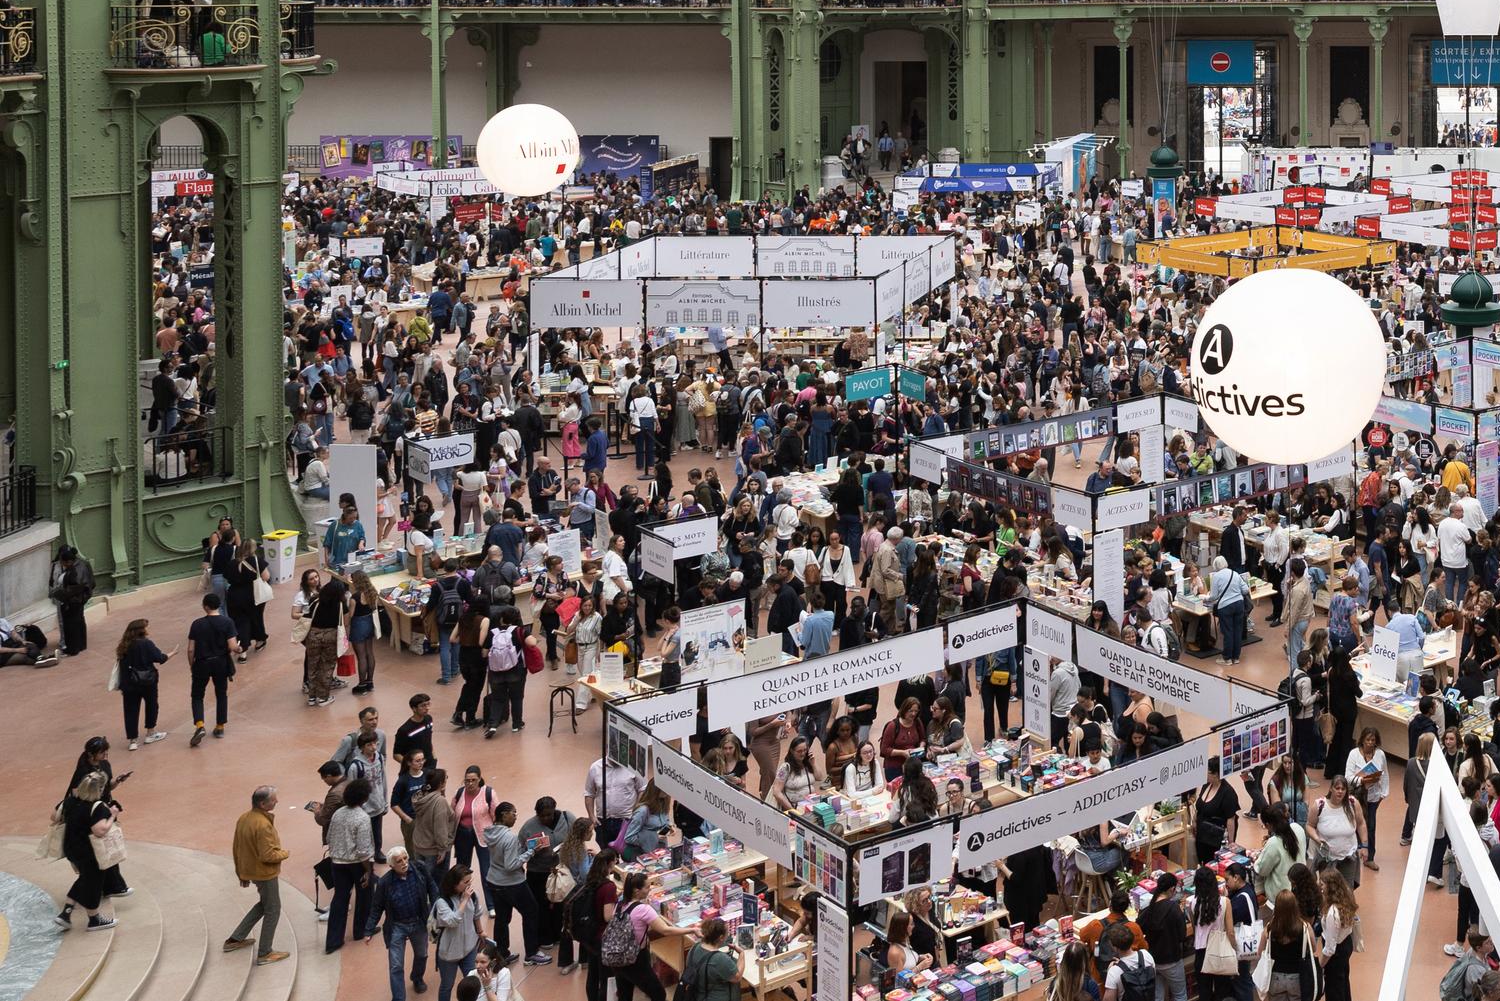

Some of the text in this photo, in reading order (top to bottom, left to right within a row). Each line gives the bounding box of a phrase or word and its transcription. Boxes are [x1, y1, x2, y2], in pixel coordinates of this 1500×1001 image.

[1434, 47, 1500, 56] SORTIE EXIT
[184, 171, 195, 181] LU
[436, 182, 459, 196] folio
[680, 249, 731, 260] Littérature
[797, 296, 841, 307] Illustrés
[550, 302, 622, 317] Albin Michel
[1450, 346, 1457, 355] 10
[1450, 357, 1458, 366] 18
[852, 377, 884, 393] PAYOT
[1123, 407, 1155, 421] ACTES SUD
[1441, 420, 1467, 433] POCKET
[430, 449, 460, 462] LAFON
[433, 443, 458, 454] Michel
[1314, 454, 1346, 471] ACTES SUD
[1059, 502, 1087, 517] ACTES SUD
[1105, 501, 1144, 517] ACTES SUD
[684, 531, 706, 540] MOTS
[965, 621, 1014, 644] addictives
[1040, 626, 1065, 646] ADONIA
[1373, 643, 1396, 661] Grèce
[762, 648, 893, 693] QUAND LA ROMANCE
[1099, 646, 1200, 694] QUAND LA ROMANCE
[753, 660, 903, 711] RENCONTRE LA FANTASY
[1025, 671, 1048, 686] addictives
[1109, 663, 1191, 703] SE FAIT SOMBRE
[640, 707, 693, 729] ddictives
[986, 754, 1205, 842] addictives ADDICTASY ADONIA
[663, 765, 788, 850] addictives ADDICTASY ADONIA
